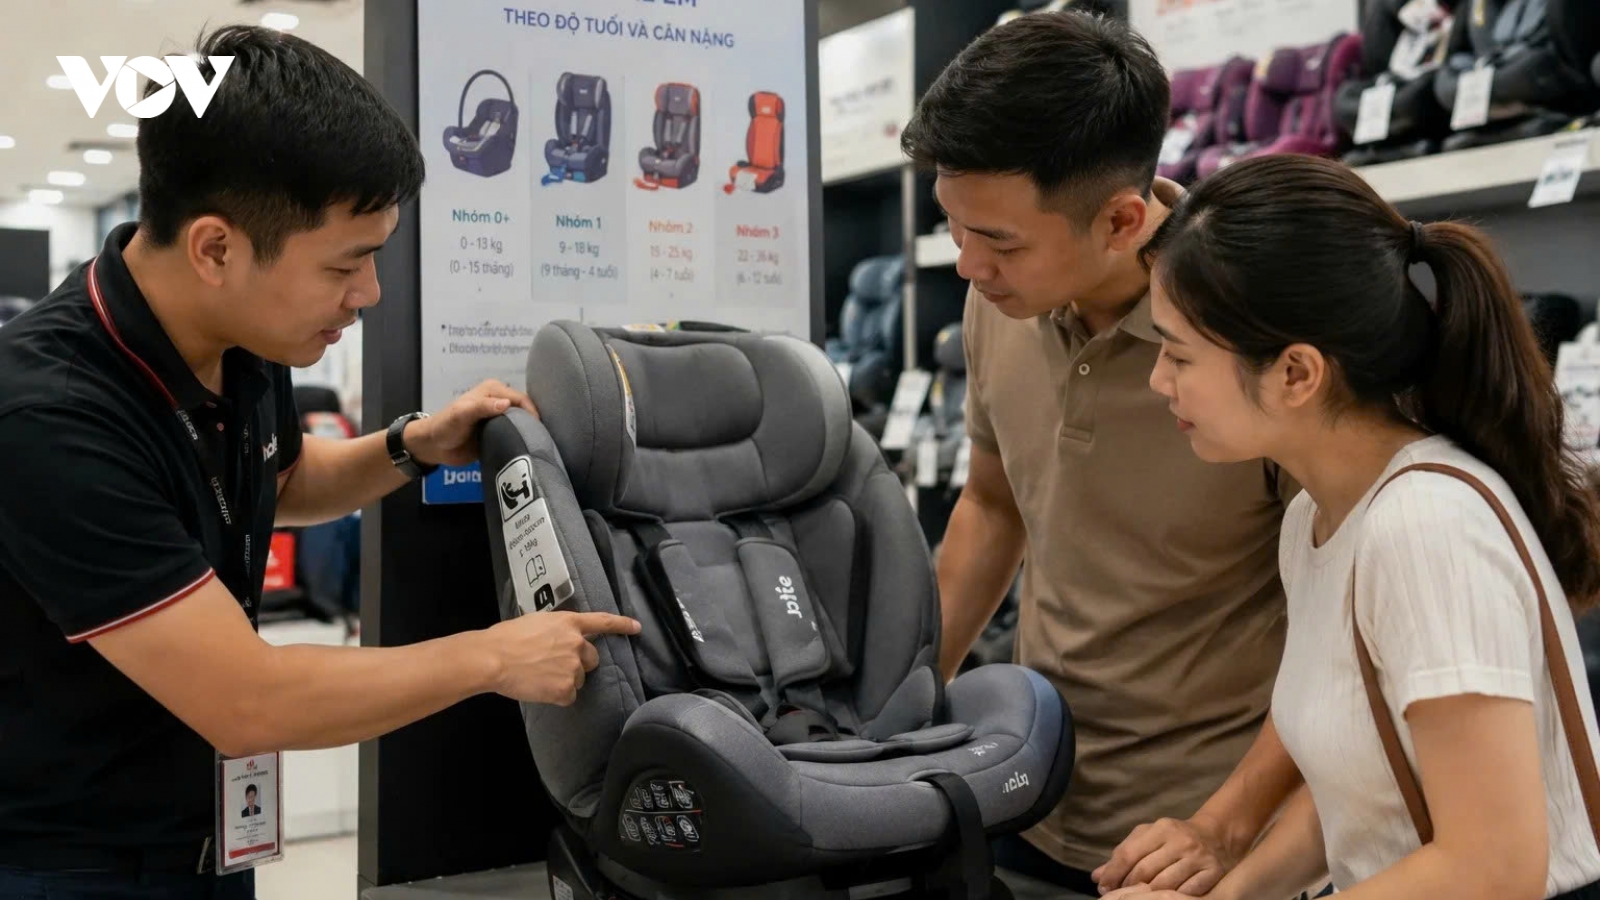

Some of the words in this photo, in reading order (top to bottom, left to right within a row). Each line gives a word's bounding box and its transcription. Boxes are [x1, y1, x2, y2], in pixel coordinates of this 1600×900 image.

[503, 7, 550, 28] THEO
[554, 11, 580, 36] ĐỘ
[584, 13, 624, 37] TUỐI
[627, 20, 649, 39] VÀ
[452, 208, 491, 223] Nhóm
[494, 211, 510, 224] 0+
[556, 214, 593, 229] Nhóm
[596, 216, 602, 229] 1
[649, 219, 684, 234] Nhóm
[685, 221, 693, 234] 2
[736, 224, 770, 238] Nhóm
[771, 225, 780, 241] 3
[460, 236, 468, 250] 0
[476, 236, 488, 250] 13
[490, 236, 503, 254] kg
[559, 240, 567, 254] 9
[574, 241, 586, 254] 18
[587, 241, 600, 258] kg
[449, 259, 460, 274] (0
[469, 260, 481, 274] 15
